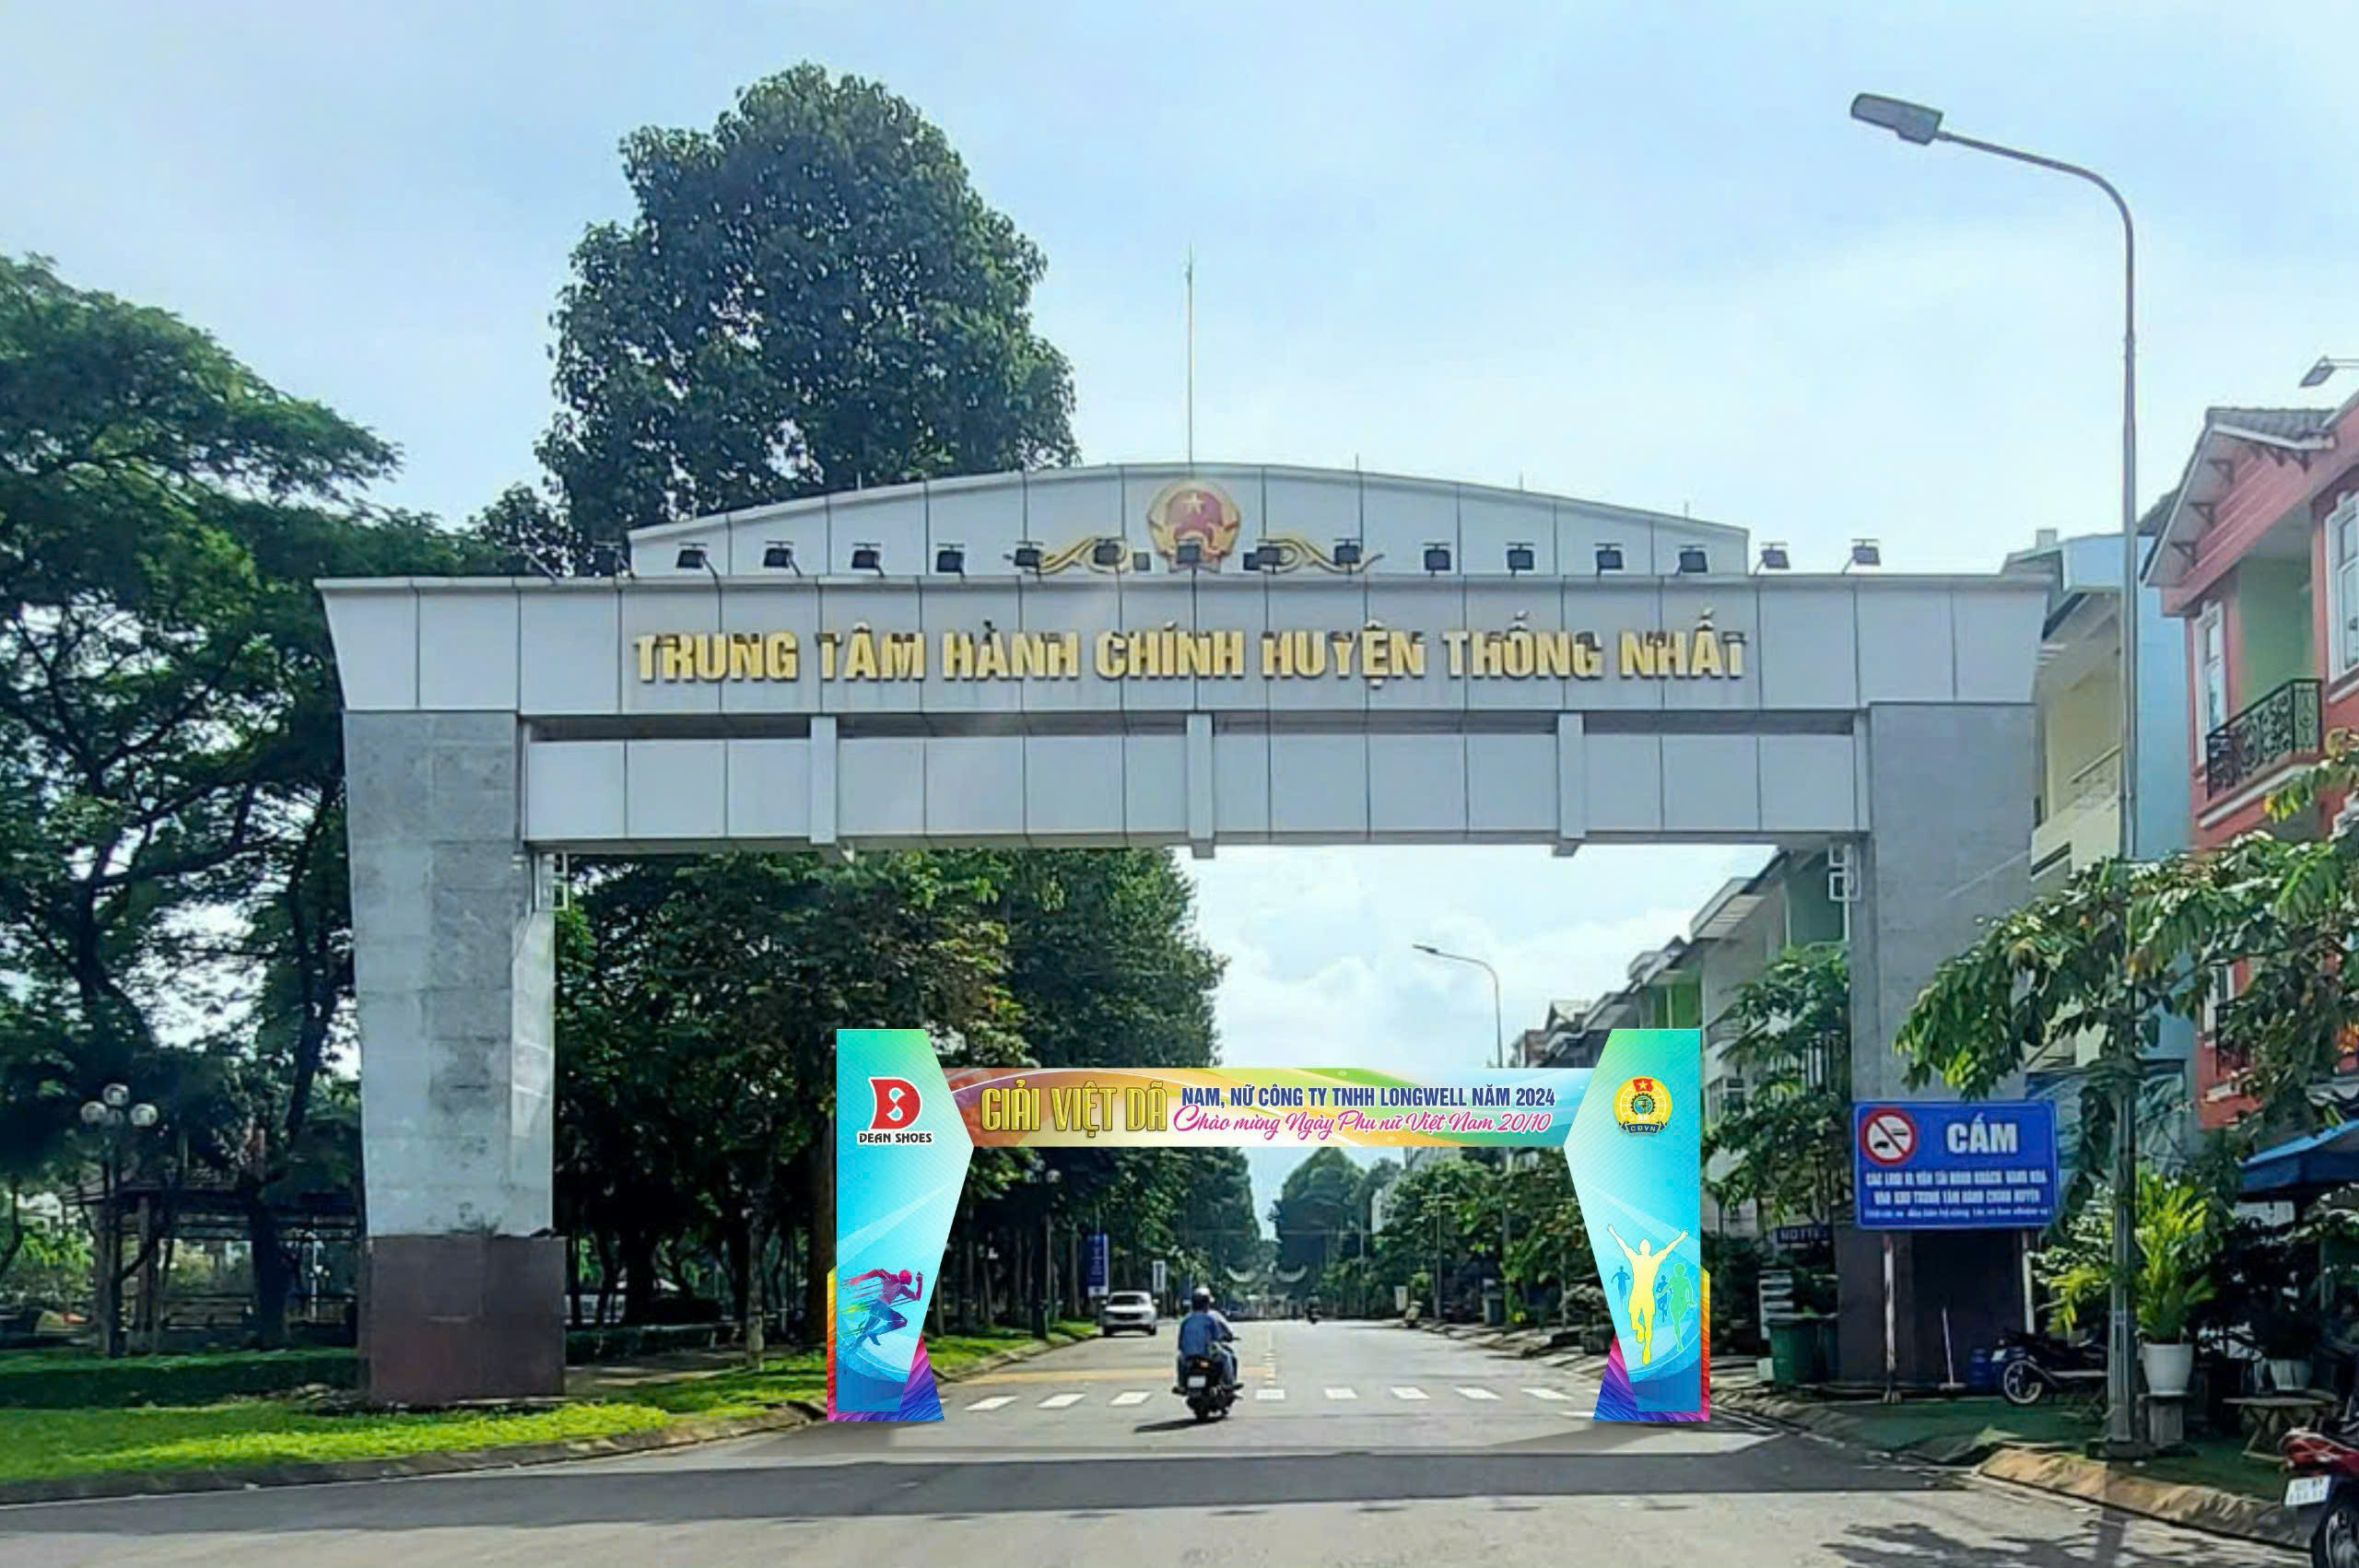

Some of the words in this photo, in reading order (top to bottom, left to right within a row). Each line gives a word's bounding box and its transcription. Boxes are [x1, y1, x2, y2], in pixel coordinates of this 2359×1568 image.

[635, 631, 799, 682] TRUNG
[816, 621, 926, 682] TÂM
[942, 619, 1080, 681] HÀNH
[1094, 620, 1244, 680] CHÍNH
[1262, 618, 1425, 689] HUYỆN
[1442, 610, 1602, 680] THỐNG
[1619, 607, 1746, 680] NHẤT
[980, 1079, 1040, 1131] GIẢI
[1051, 1081, 1117, 1138] VIỆT
[1125, 1082, 1167, 1131] DÃ
[1181, 1088, 1225, 1108] NAM,
[1230, 1083, 1255, 1106] NỮ
[1259, 1083, 1303, 1106] CÔNG
[1309, 1087, 1325, 1106] TY
[1332, 1087, 1374, 1106] TNHH
[1380, 1087, 1467, 1106] LONGWELL
[1473, 1084, 1511, 1106] NĂM
[1516, 1087, 1555, 1106] 2024
[859, 1133, 891, 1143] DEAN
[895, 1133, 933, 1143] SHOES
[1174, 1105, 1230, 1131] Chào
[1233, 1111, 1281, 1141] mừng
[1285, 1111, 1337, 1141] Ngày
[1338, 1109, 1378, 1133] Phụ
[1379, 1113, 1404, 1131] nữ
[1405, 1110, 1446, 1134] Việt
[1448, 1110, 1494, 1132] Nam
[1496, 1112, 1552, 1133] 20/10
